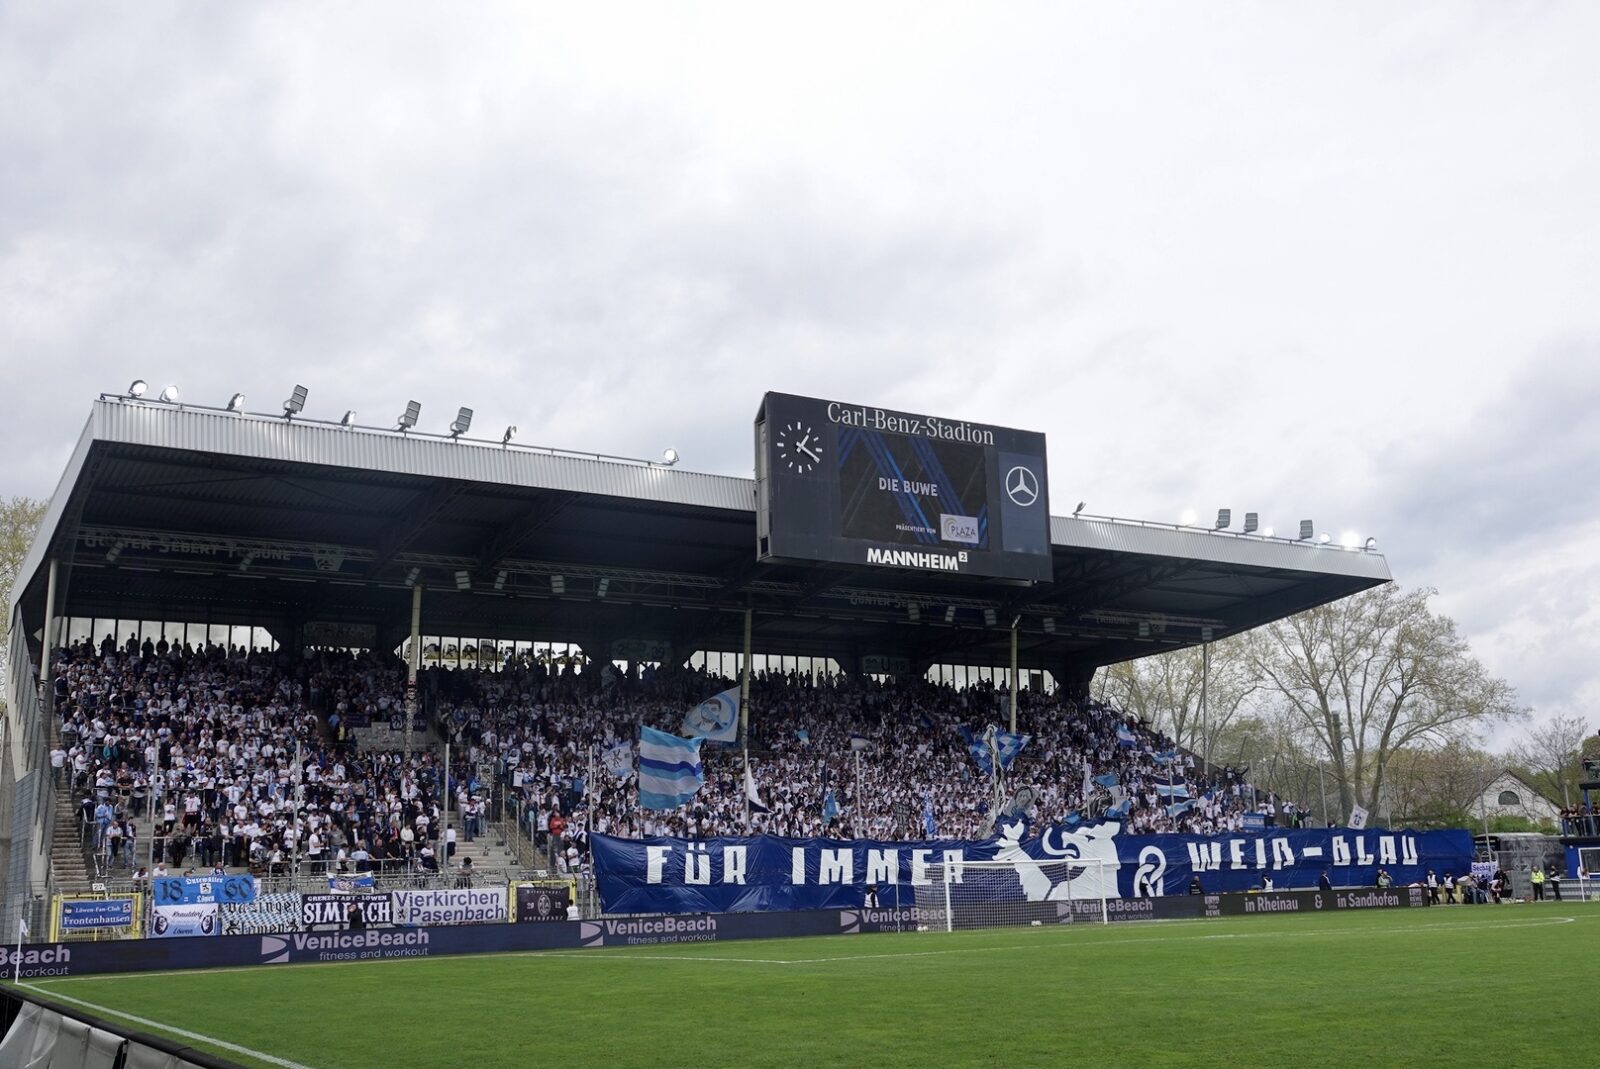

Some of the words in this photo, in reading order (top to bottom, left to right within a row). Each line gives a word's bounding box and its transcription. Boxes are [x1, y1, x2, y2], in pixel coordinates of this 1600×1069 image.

[828, 402, 994, 445] Carl-Benz-Stadion
[879, 477, 899, 492] DIE
[903, 481, 938, 497] BUWE
[951, 525, 976, 536] PLAZA
[791, 848, 964, 886] IMMER
[160, 880, 183, 901] 18
[395, 890, 500, 907] Vierkirchen
[1244, 896, 1255, 912] in
[1257, 892, 1298, 911] Rheinau
[1315, 895, 1323, 909] &
[1337, 893, 1348, 908] in
[1349, 889, 1399, 908] Sandhofen
[64, 915, 130, 925] Frontenhausen
[409, 905, 504, 922] Pasenbach
[606, 915, 717, 935] VeniceBeach
[292, 928, 429, 950] VeniceBeach
[628, 935, 658, 945] fitness
[661, 934, 677, 943] and
[679, 932, 716, 942] workout
[319, 951, 356, 961] fitness
[360, 949, 381, 959] and
[384, 947, 429, 958] workout
